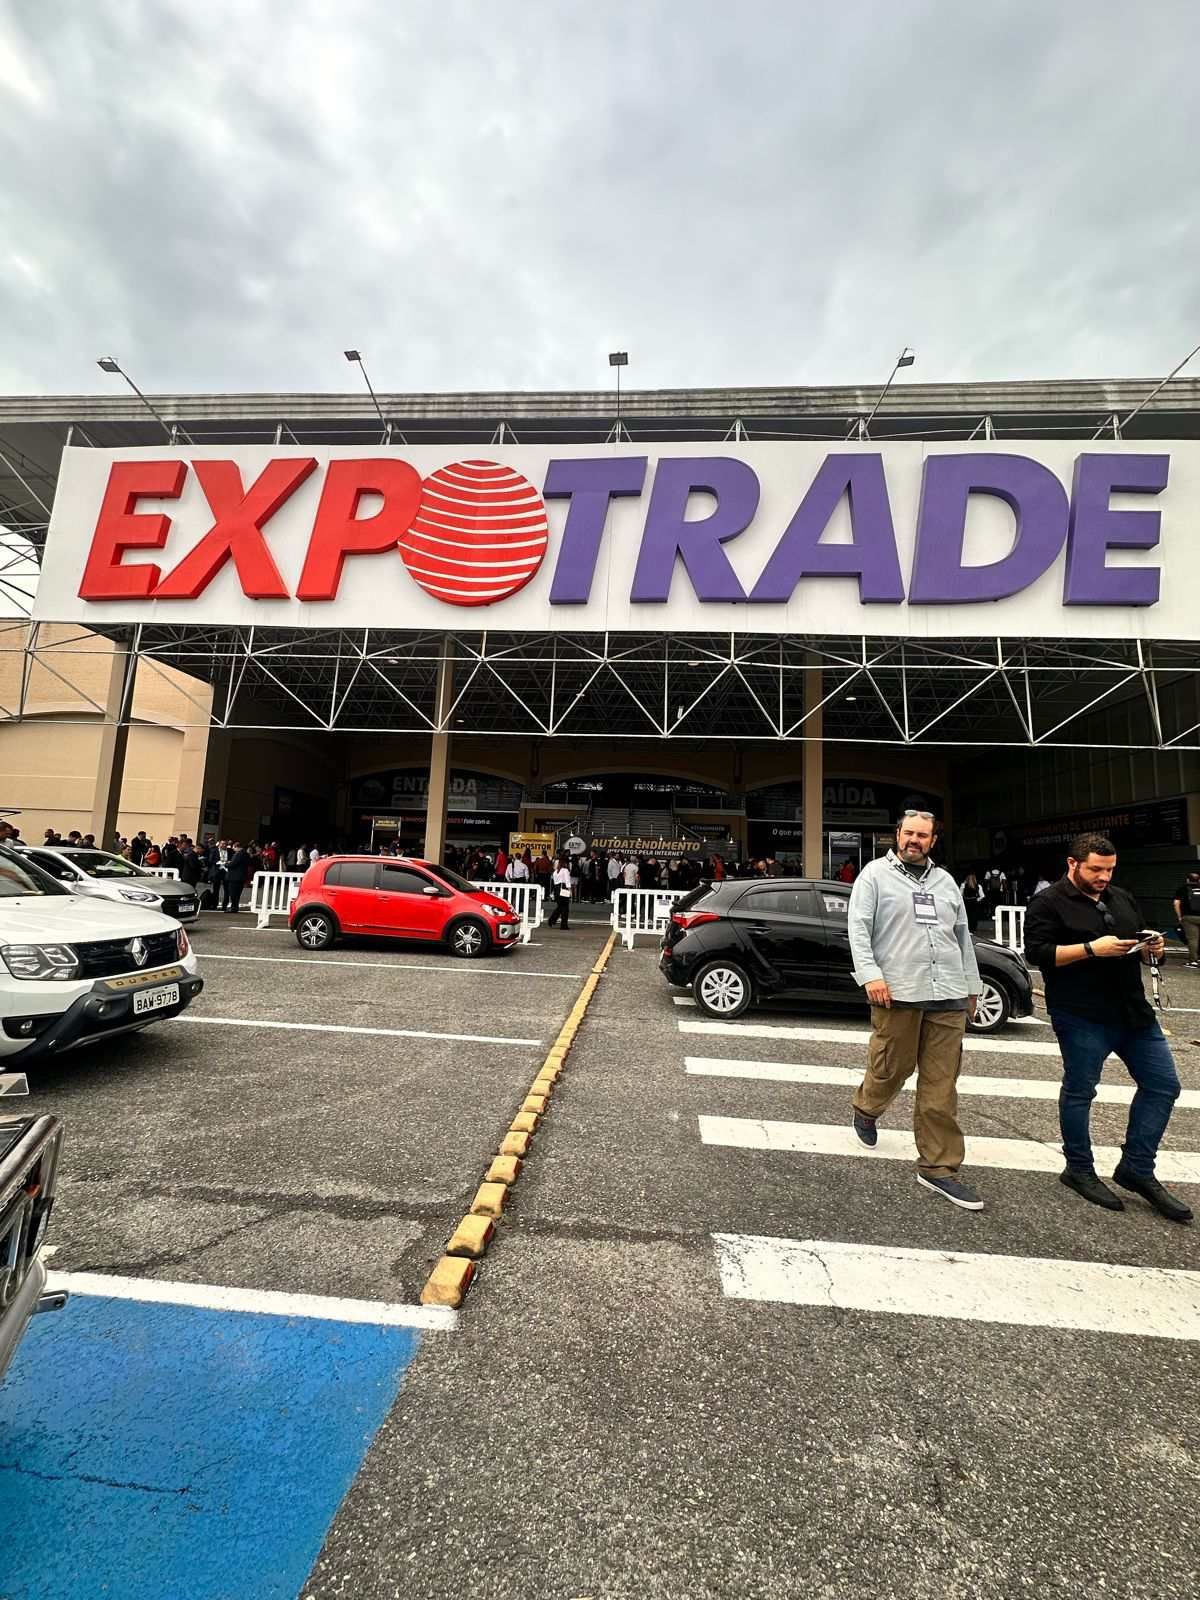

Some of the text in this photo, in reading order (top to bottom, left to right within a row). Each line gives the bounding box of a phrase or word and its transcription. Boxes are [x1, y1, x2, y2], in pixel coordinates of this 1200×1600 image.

[78, 453, 1170, 607] EXPOTRADE
[391, 776, 478, 794] ENTDA
[823, 783, 877, 805] AÍDA
[510, 842, 552, 851] EXPOSITOR
[591, 838, 701, 852] AUTOATENDIMENTO
[115, 970, 177, 986] DUSTER
[136, 991, 178, 1011] BAW-9778
